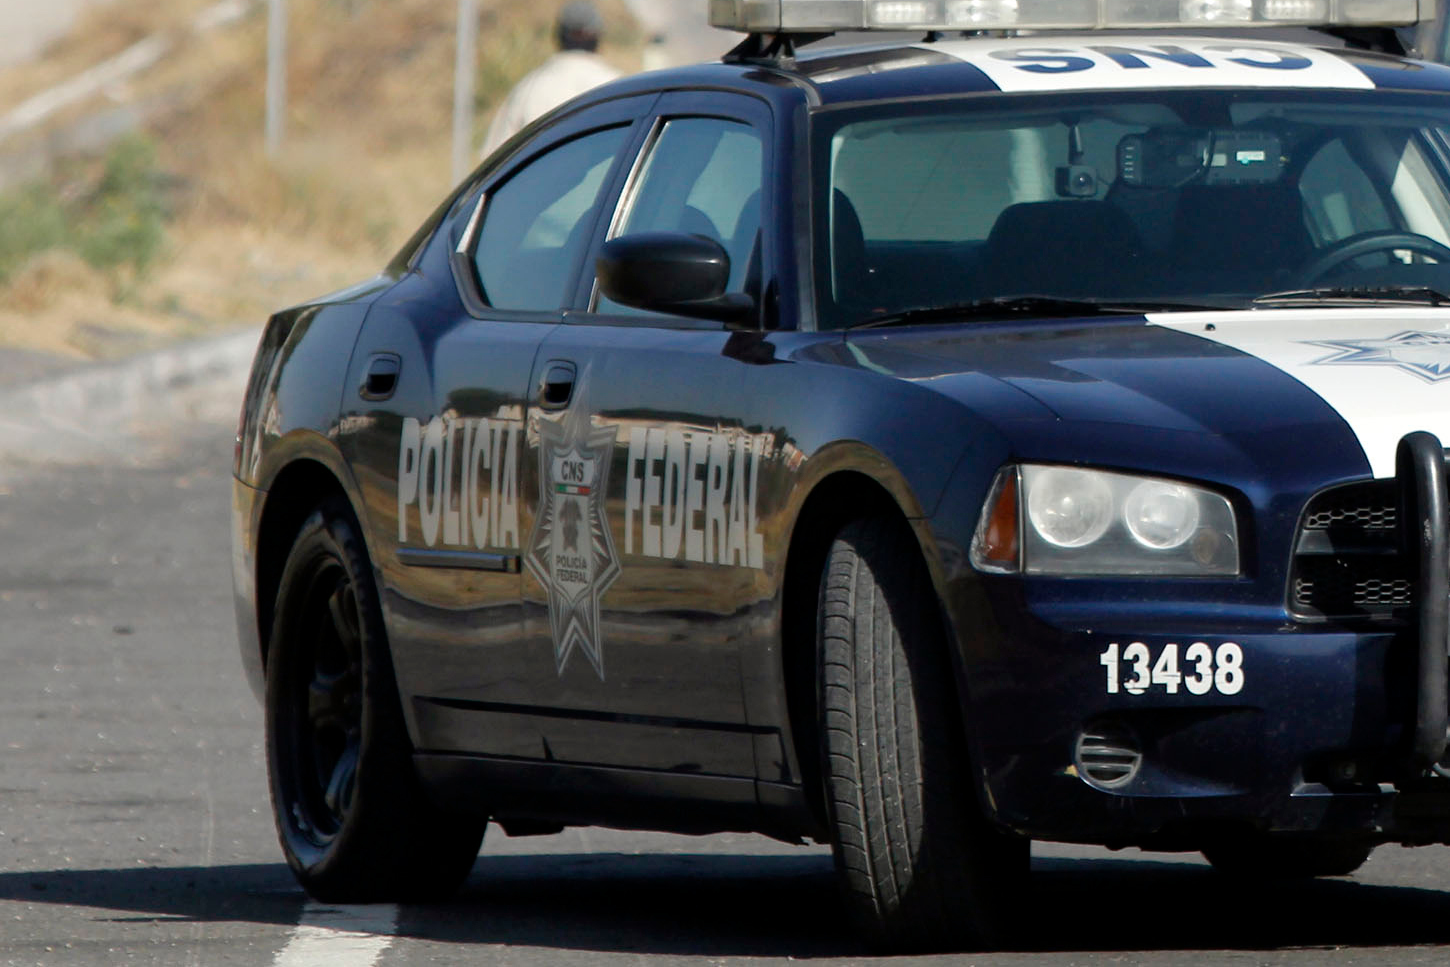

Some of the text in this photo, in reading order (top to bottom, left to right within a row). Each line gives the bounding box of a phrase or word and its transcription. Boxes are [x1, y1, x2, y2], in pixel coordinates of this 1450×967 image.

[561, 460, 585, 482] CNS
[398, 415, 765, 570] POLICIA FEDERAL
[556, 568, 588, 584] FEDERAL
[1100, 641, 1245, 695] 13438
